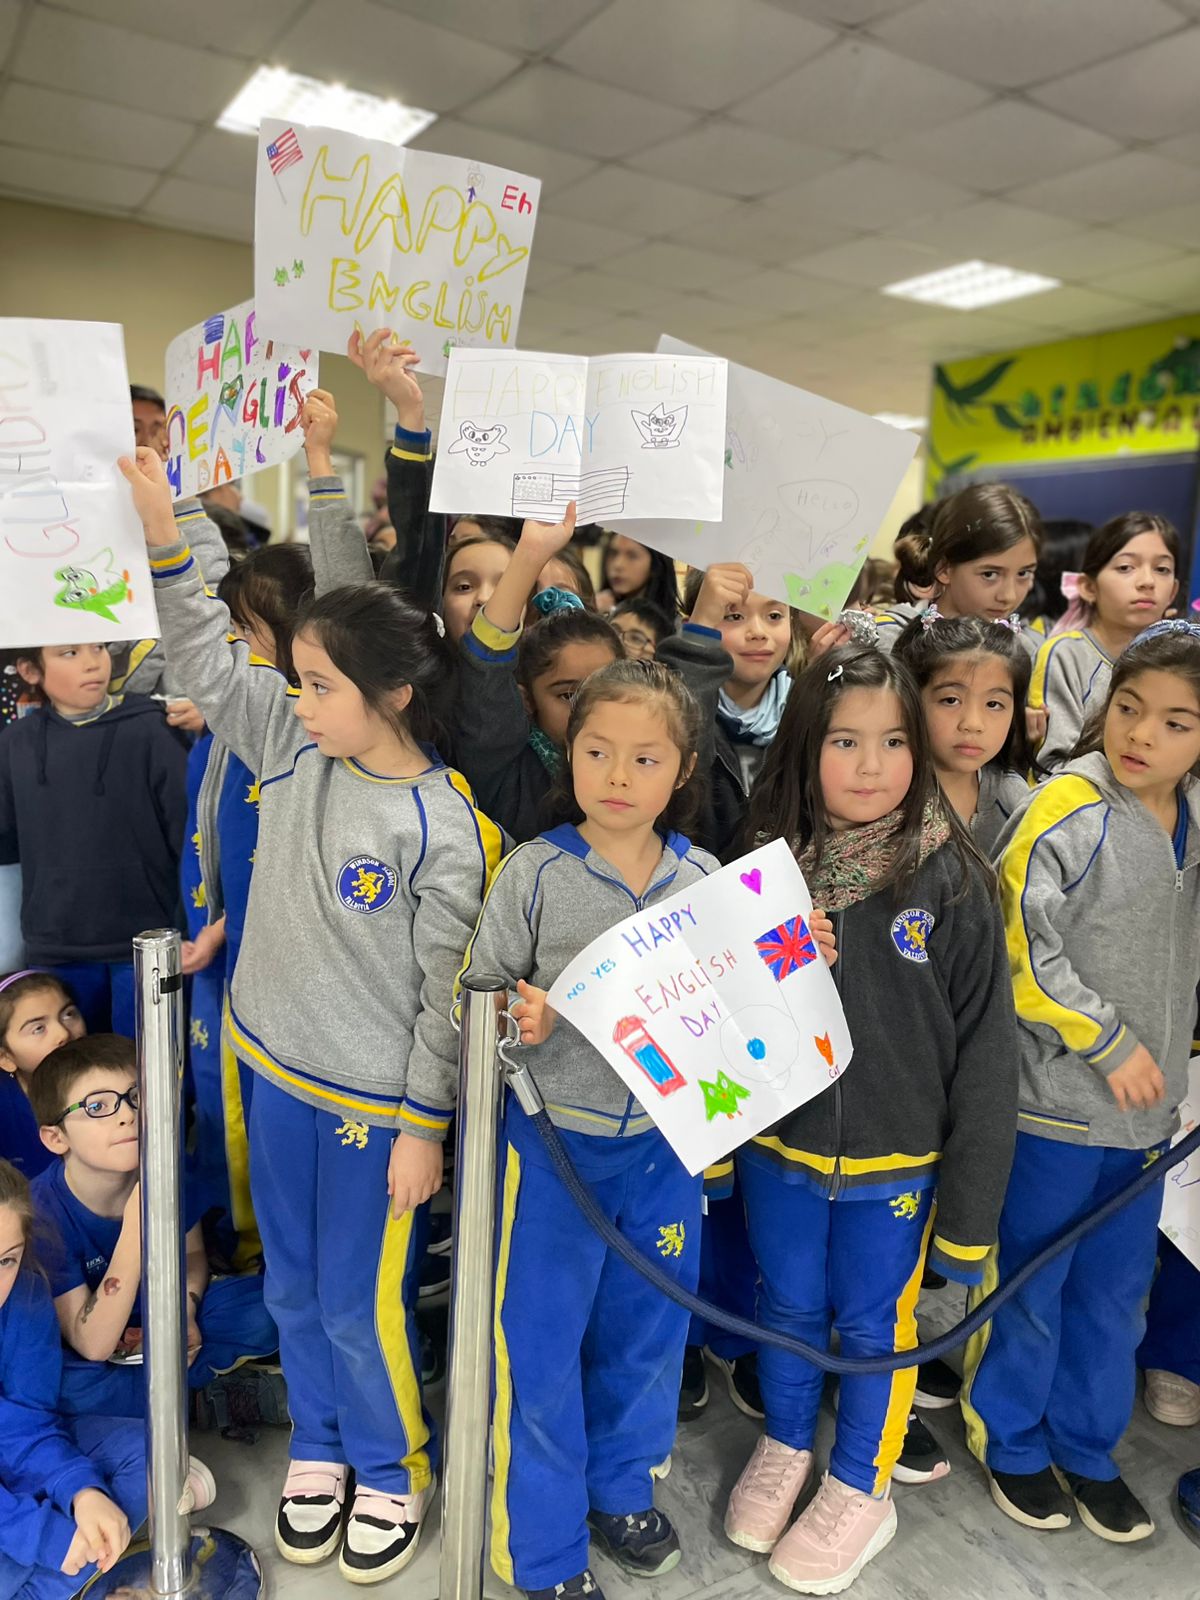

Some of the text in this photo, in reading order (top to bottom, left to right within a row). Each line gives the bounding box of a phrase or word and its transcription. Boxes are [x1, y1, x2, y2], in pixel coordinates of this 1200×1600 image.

[300, 145, 529, 283] HAPPY
[453, 366, 586, 421] HAPPY
[530, 410, 600, 457] DAY
[622, 904, 698, 958] HAPPY
[566, 958, 616, 1001] NO YES
[680, 1001, 722, 1037] DAY
